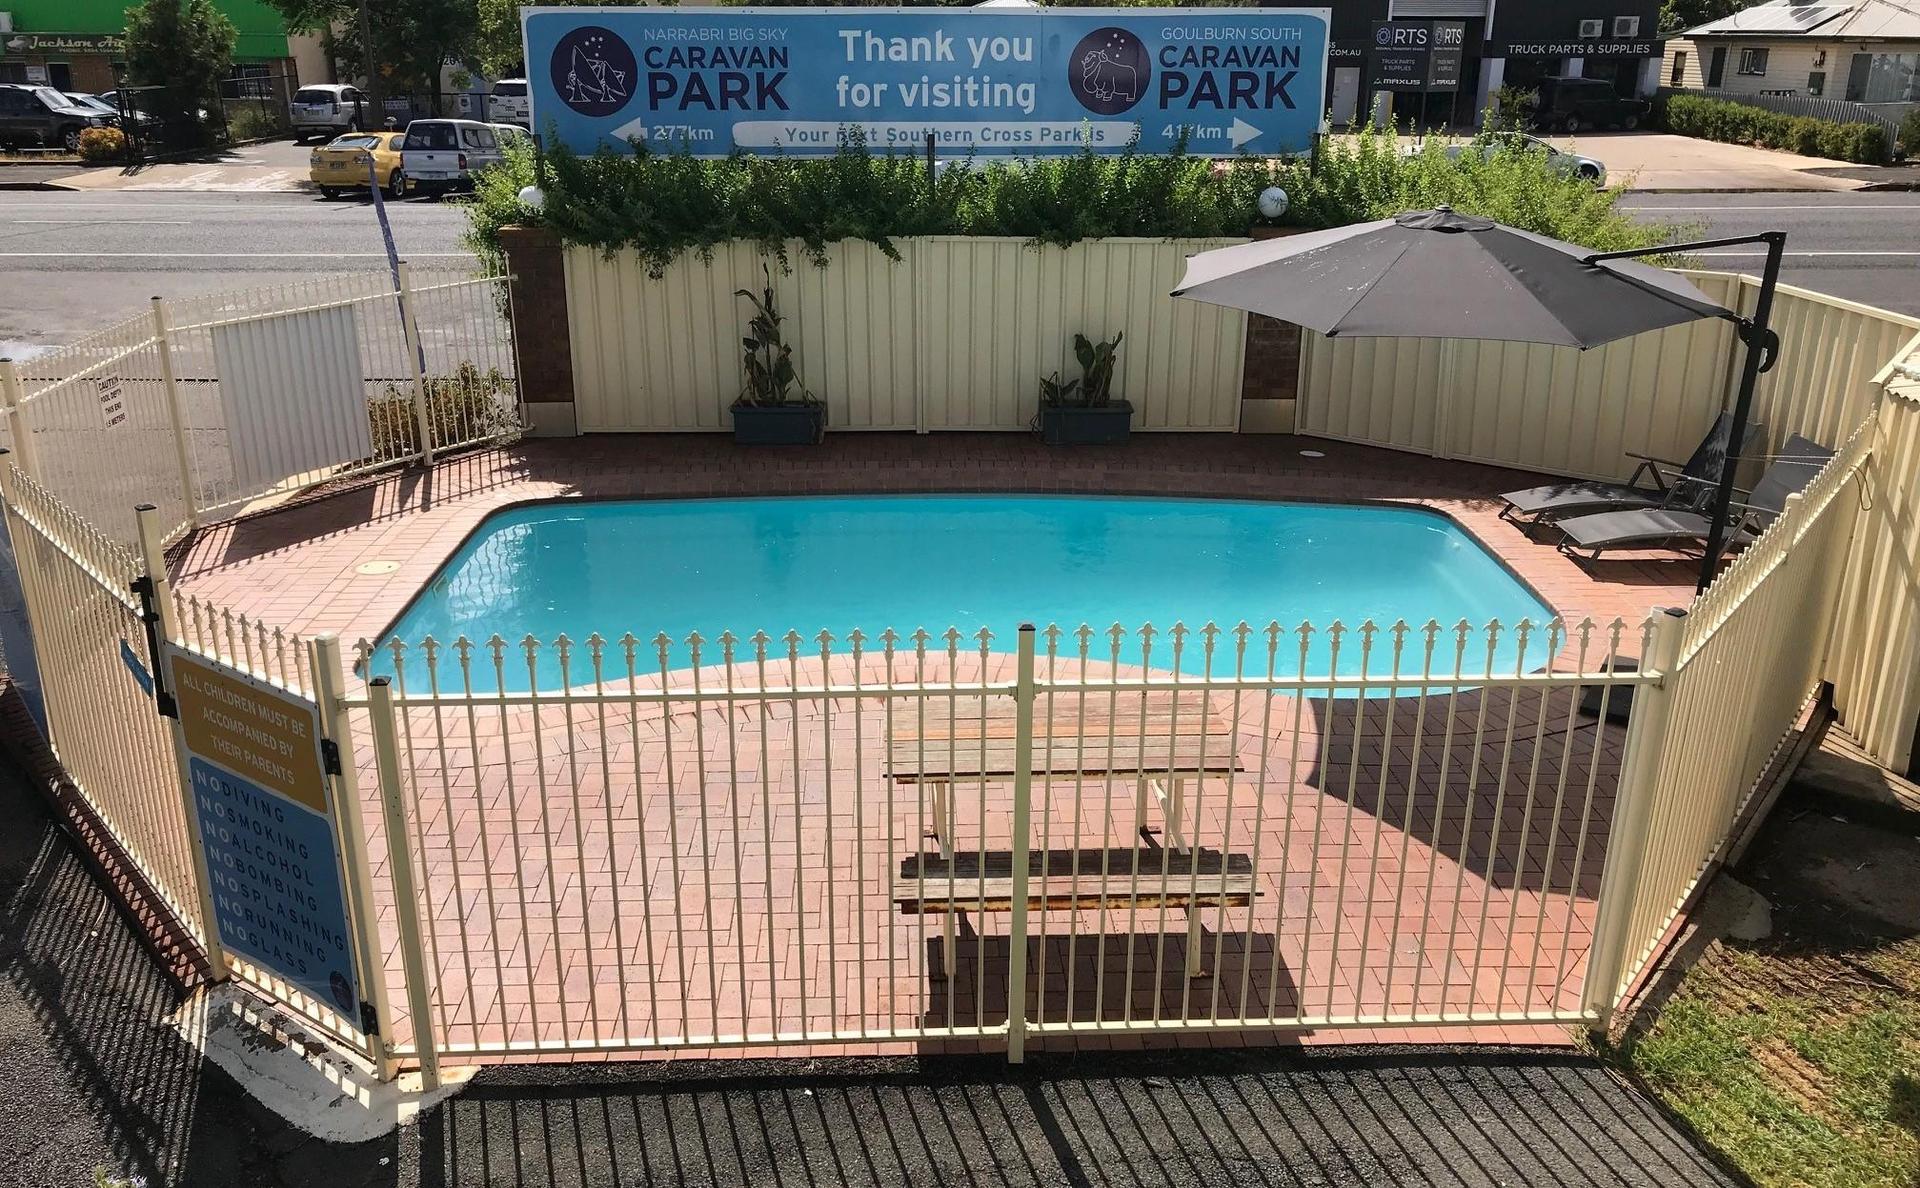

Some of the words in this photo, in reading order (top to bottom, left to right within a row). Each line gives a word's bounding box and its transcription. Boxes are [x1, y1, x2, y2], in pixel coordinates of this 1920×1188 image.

[29, 36, 93, 49] Jackson
[644, 28, 724, 41] NARRABRI
[729, 28, 754, 41] BIG
[758, 28, 790, 41] SKY
[838, 30, 956, 62] Thank
[968, 36, 1033, 68] you
[1161, 28, 1247, 41] GOULBURN
[1250, 28, 1302, 41] SOUTH
[1394, 28, 1428, 44] RTS
[1445, 28, 1462, 44] RTS
[1508, 44, 1546, 54] TRUCK
[1548, 44, 1585, 54] PARTS
[1586, 44, 1595, 54] &
[1597, 44, 1650, 54] SUPPLIES
[644, 46, 790, 69] CARAVAN
[1159, 45, 1300, 69] CARAVAN
[648, 72, 790, 110] PARK
[837, 75, 888, 108] for
[899, 75, 1037, 113] visiting
[1160, 71, 1297, 110] PARK
[653, 125, 714, 141] 277km
[785, 128, 829, 142] Your
[887, 128, 973, 142] Southern
[981, 128, 1033, 142] Cross
[1040, 128, 1082, 142] Park
[1090, 127, 1105, 142] is
[183, 672, 202, 692] ALL
[203, 682, 256, 716] CHILDREN
[258, 704, 288, 730] MUST
[291, 719, 307, 738] BE
[202, 706, 277, 751] ACCOMPANIED
[279, 741, 294, 759] BY
[210, 734, 242, 760] THEIR
[244, 750, 295, 785] PARENTS
[196, 768, 221, 792] NO
[221, 781, 284, 823] DIVING
[200, 794, 225, 818] NO
[227, 808, 309, 860] SMOKING
[205, 819, 230, 843] NO
[232, 833, 314, 887] ALCOHOL
[210, 845, 234, 868] NO
[235, 858, 318, 912] BOMBING
[213, 869, 239, 893] NO
[240, 883, 345, 952] SPLASHING
[218, 893, 244, 918] NO
[244, 907, 327, 963] RUNNING
[222, 917, 247, 941] NO
[249, 932, 308, 975] GLASS
